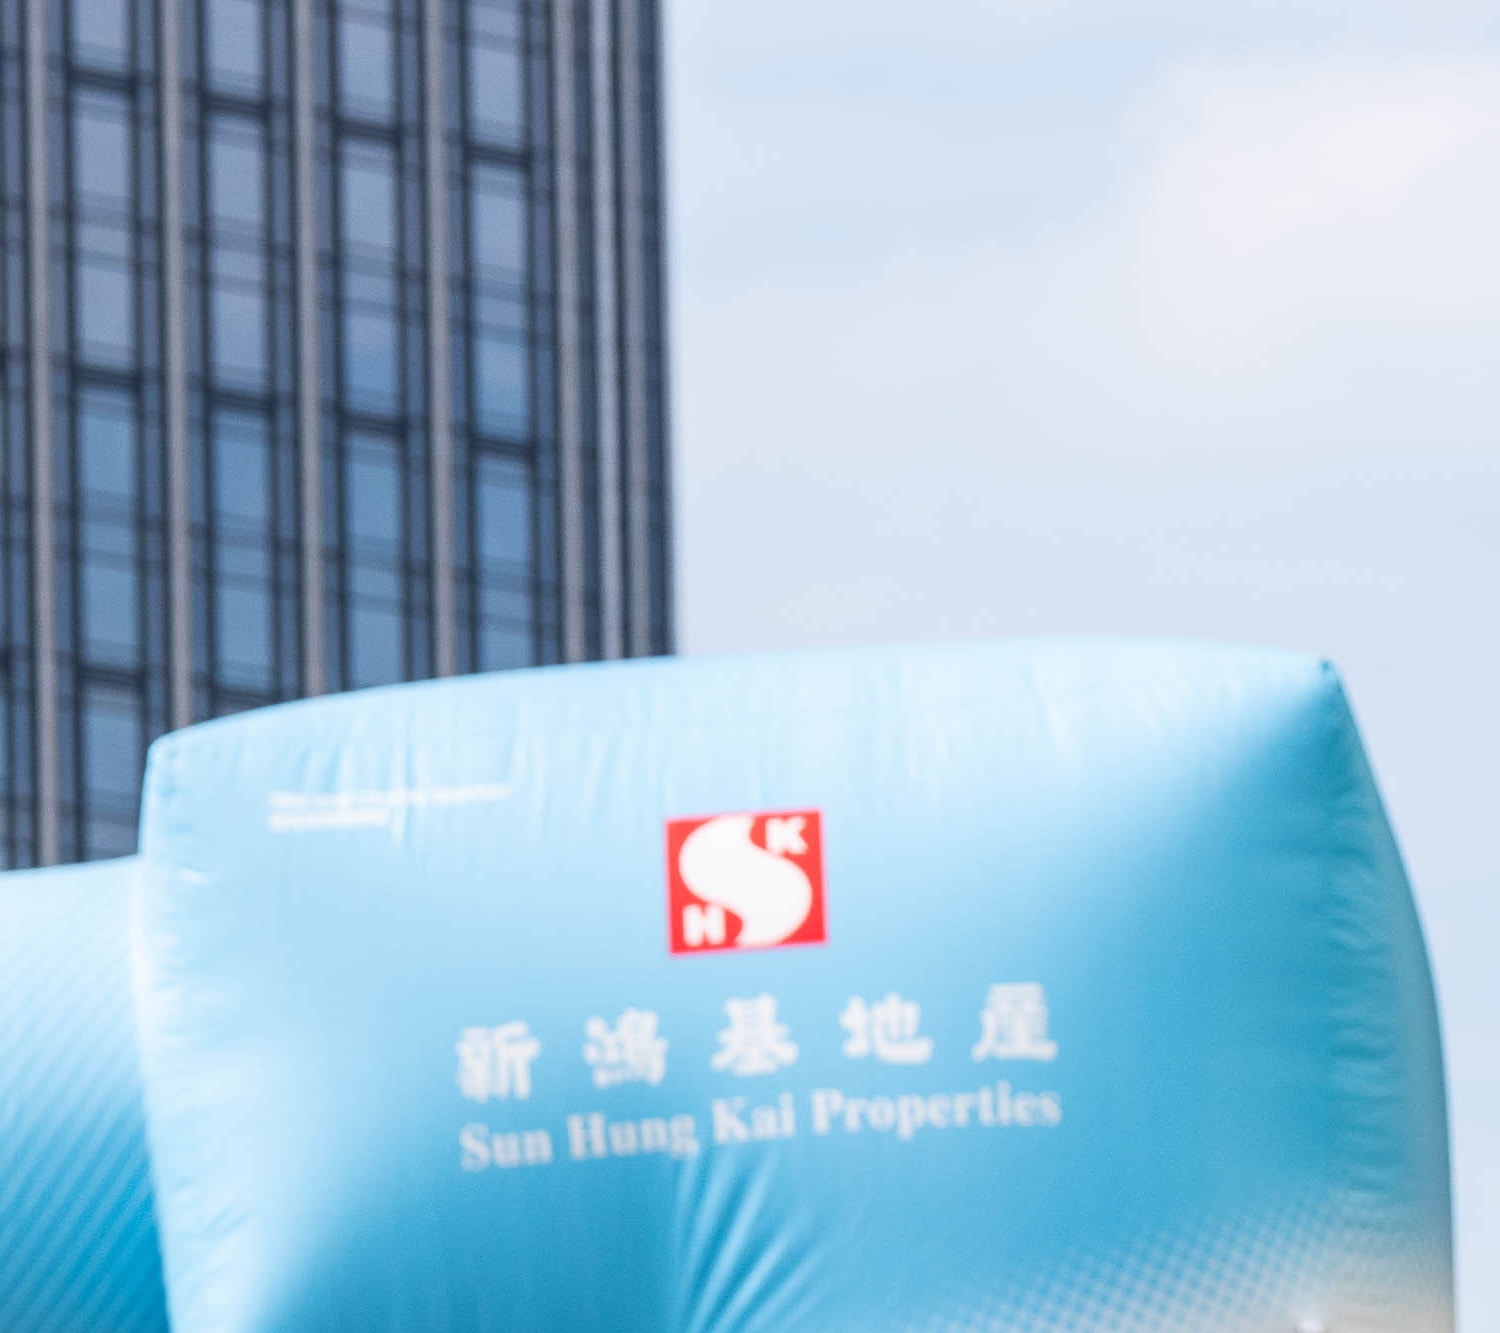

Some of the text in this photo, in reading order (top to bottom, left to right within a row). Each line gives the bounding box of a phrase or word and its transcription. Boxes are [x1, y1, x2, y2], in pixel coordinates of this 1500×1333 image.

[459, 1081, 1063, 1172] Sun Hung Kai Properties
